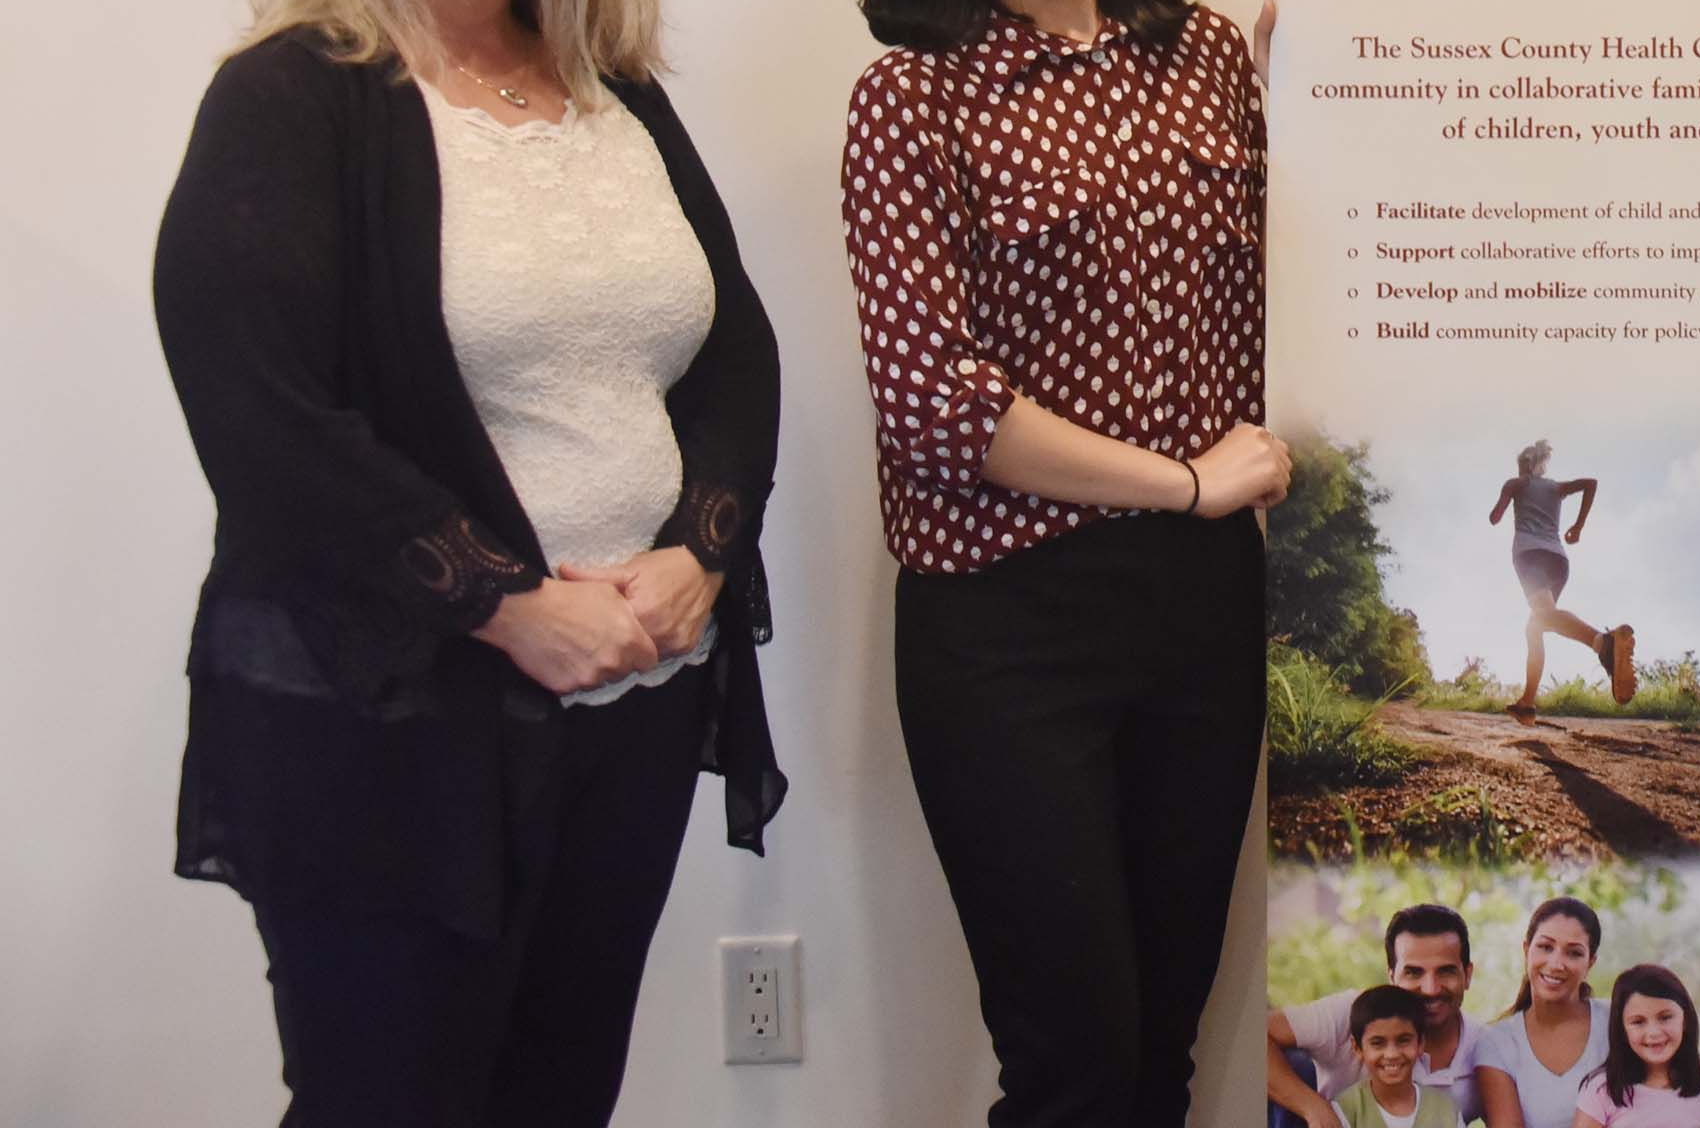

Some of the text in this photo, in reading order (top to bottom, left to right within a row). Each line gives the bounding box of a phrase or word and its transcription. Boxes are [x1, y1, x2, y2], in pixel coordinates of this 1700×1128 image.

[1351, 35, 1403, 60] The
[1410, 36, 1493, 60] Sussex
[1500, 36, 1593, 65] County
[1599, 35, 1684, 60] Health
[1311, 77, 1449, 105] community
[1456, 77, 1481, 100] in
[1488, 75, 1644, 100] collaborative
[1441, 115, 1468, 140] of
[1473, 115, 1582, 143] children,
[1590, 115, 1661, 145] youth
[1375, 200, 1467, 221] Facilitate
[1471, 200, 1590, 225] development
[1594, 200, 1615, 220] of
[1617, 200, 1663, 220] child
[1375, 241, 1456, 264] Support
[1460, 240, 1577, 261] collaborative
[1581, 240, 1641, 260] efforts
[1645, 245, 1665, 260] to
[1375, 280, 1459, 304] Develop
[1464, 280, 1499, 300] and
[1503, 280, 1588, 300] mobilize
[1592, 282, 1697, 304] community
[1375, 320, 1431, 340] Build
[1435, 322, 1539, 343] community
[1543, 321, 1618, 344] capacity
[1622, 319, 1649, 339] for
